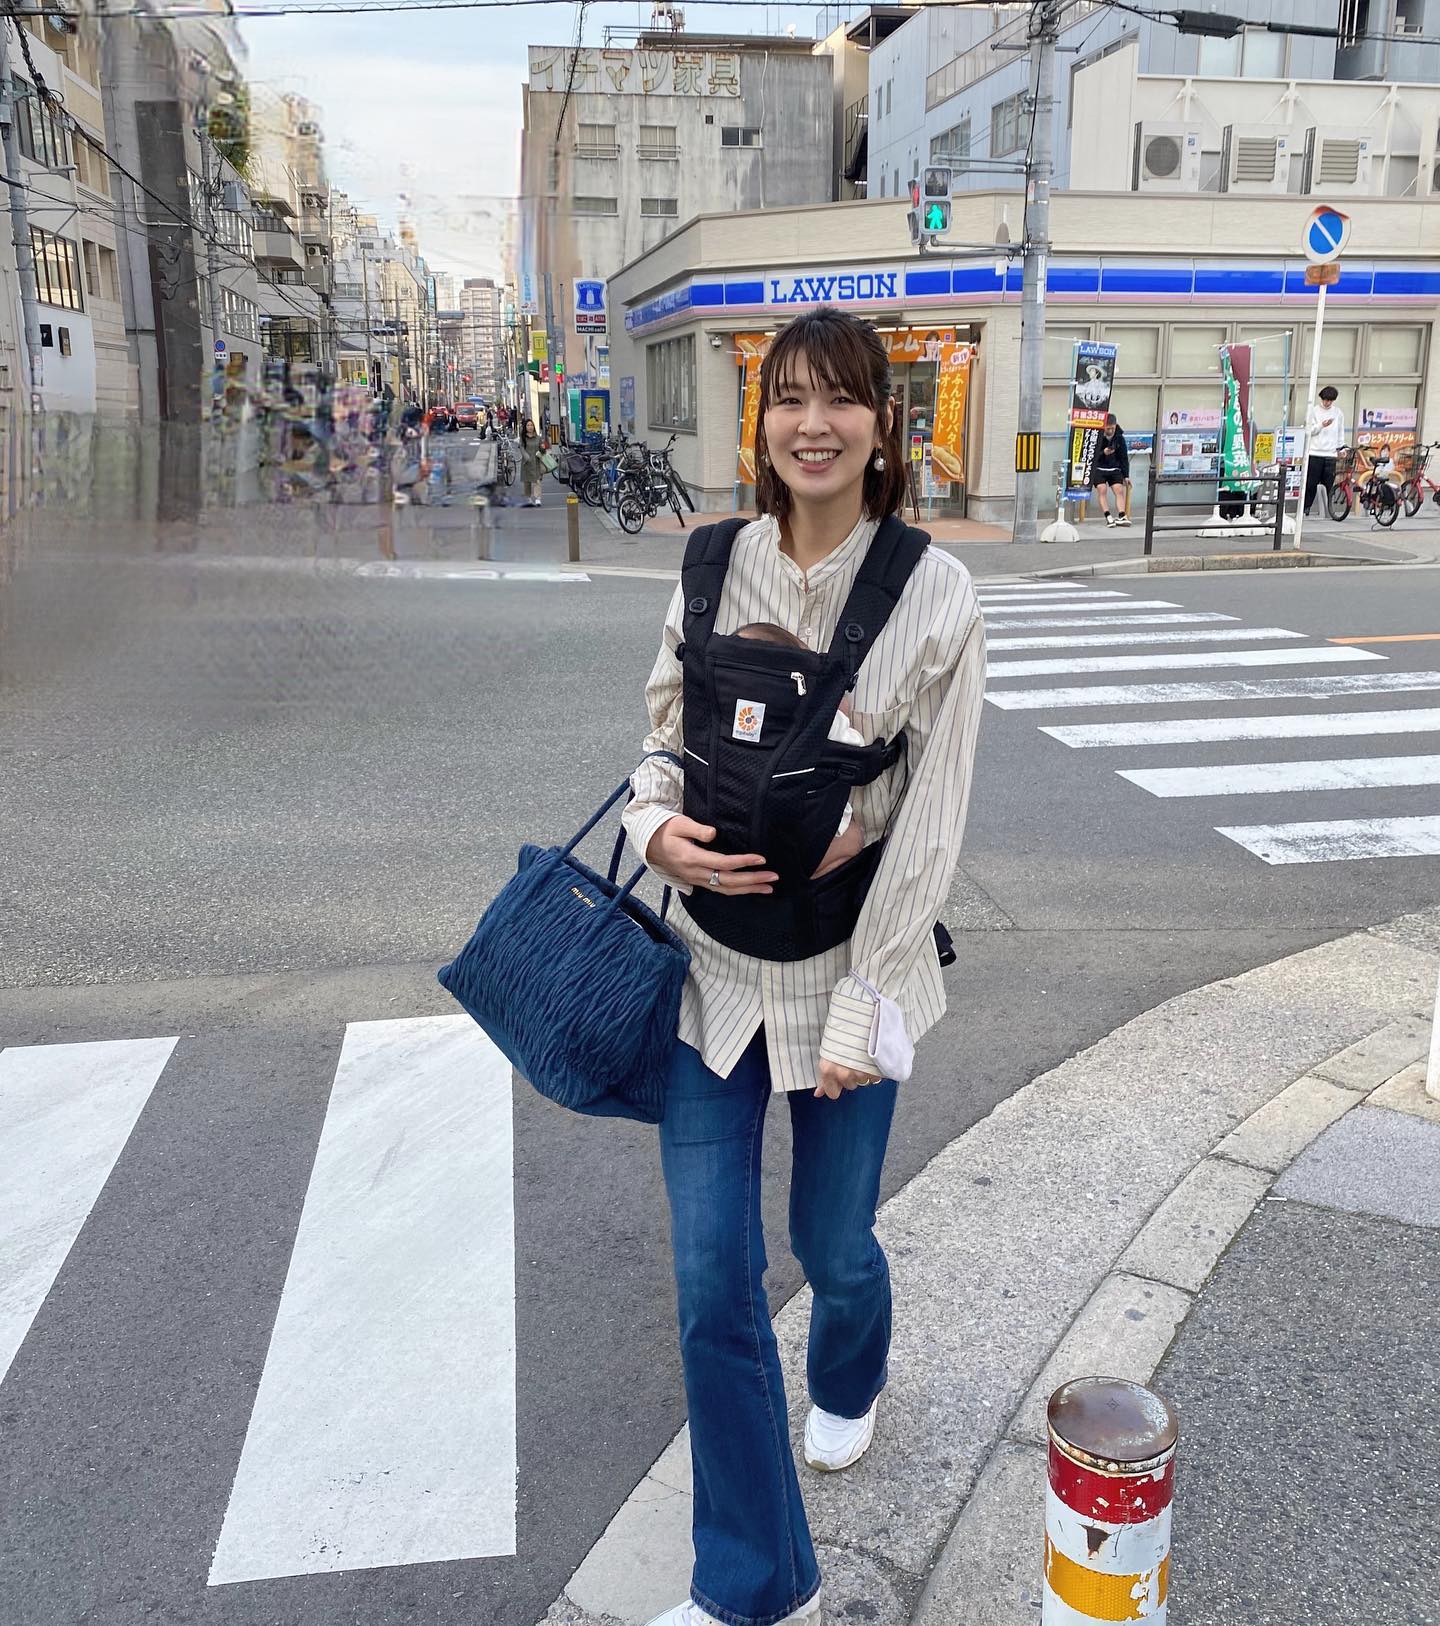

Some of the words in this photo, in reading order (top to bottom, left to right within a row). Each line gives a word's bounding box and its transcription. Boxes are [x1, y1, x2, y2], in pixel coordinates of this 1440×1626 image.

[771, 273, 897, 303] LAWSON
[881, 333, 920, 353] リーム
[1080, 345, 1116, 356] LAWSON
[938, 374, 950, 434] オムレット
[946, 375, 964, 454] ふんわりバター
[571, 887, 584, 899] miu
[582, 897, 596, 908] miu
